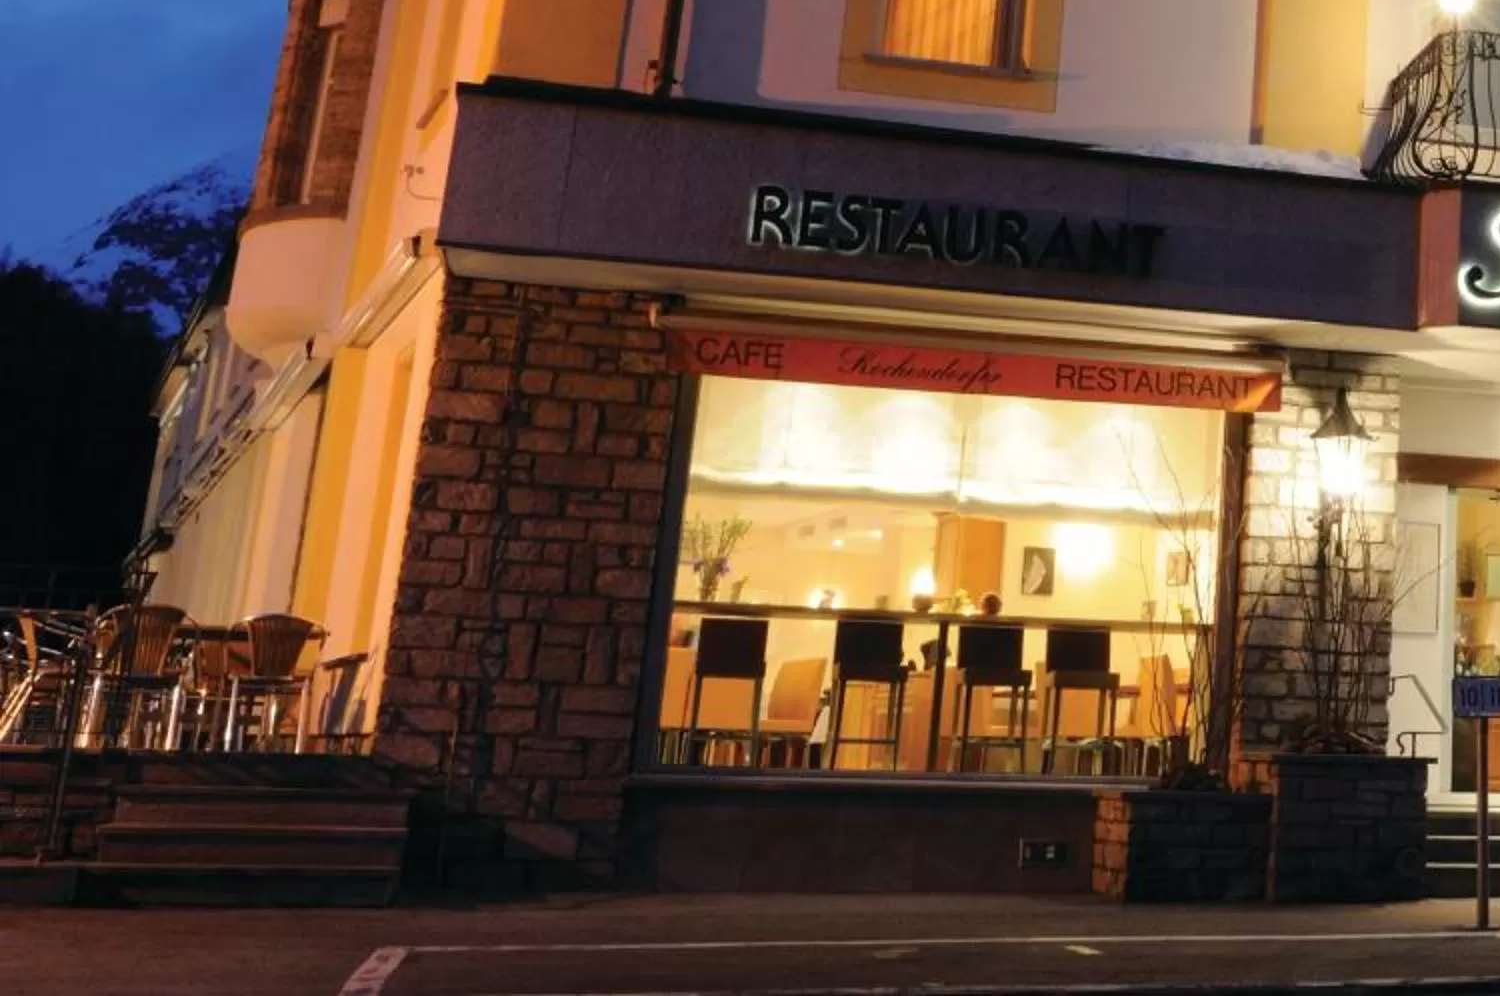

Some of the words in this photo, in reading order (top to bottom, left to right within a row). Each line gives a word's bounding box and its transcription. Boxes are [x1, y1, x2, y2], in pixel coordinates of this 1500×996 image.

[747, 185, 1167, 277] RESTAURANT
[695, 337, 785, 370] CAFE
[1054, 363, 1256, 399] RESTAURANT
[1459, 686, 1480, 708] 10
